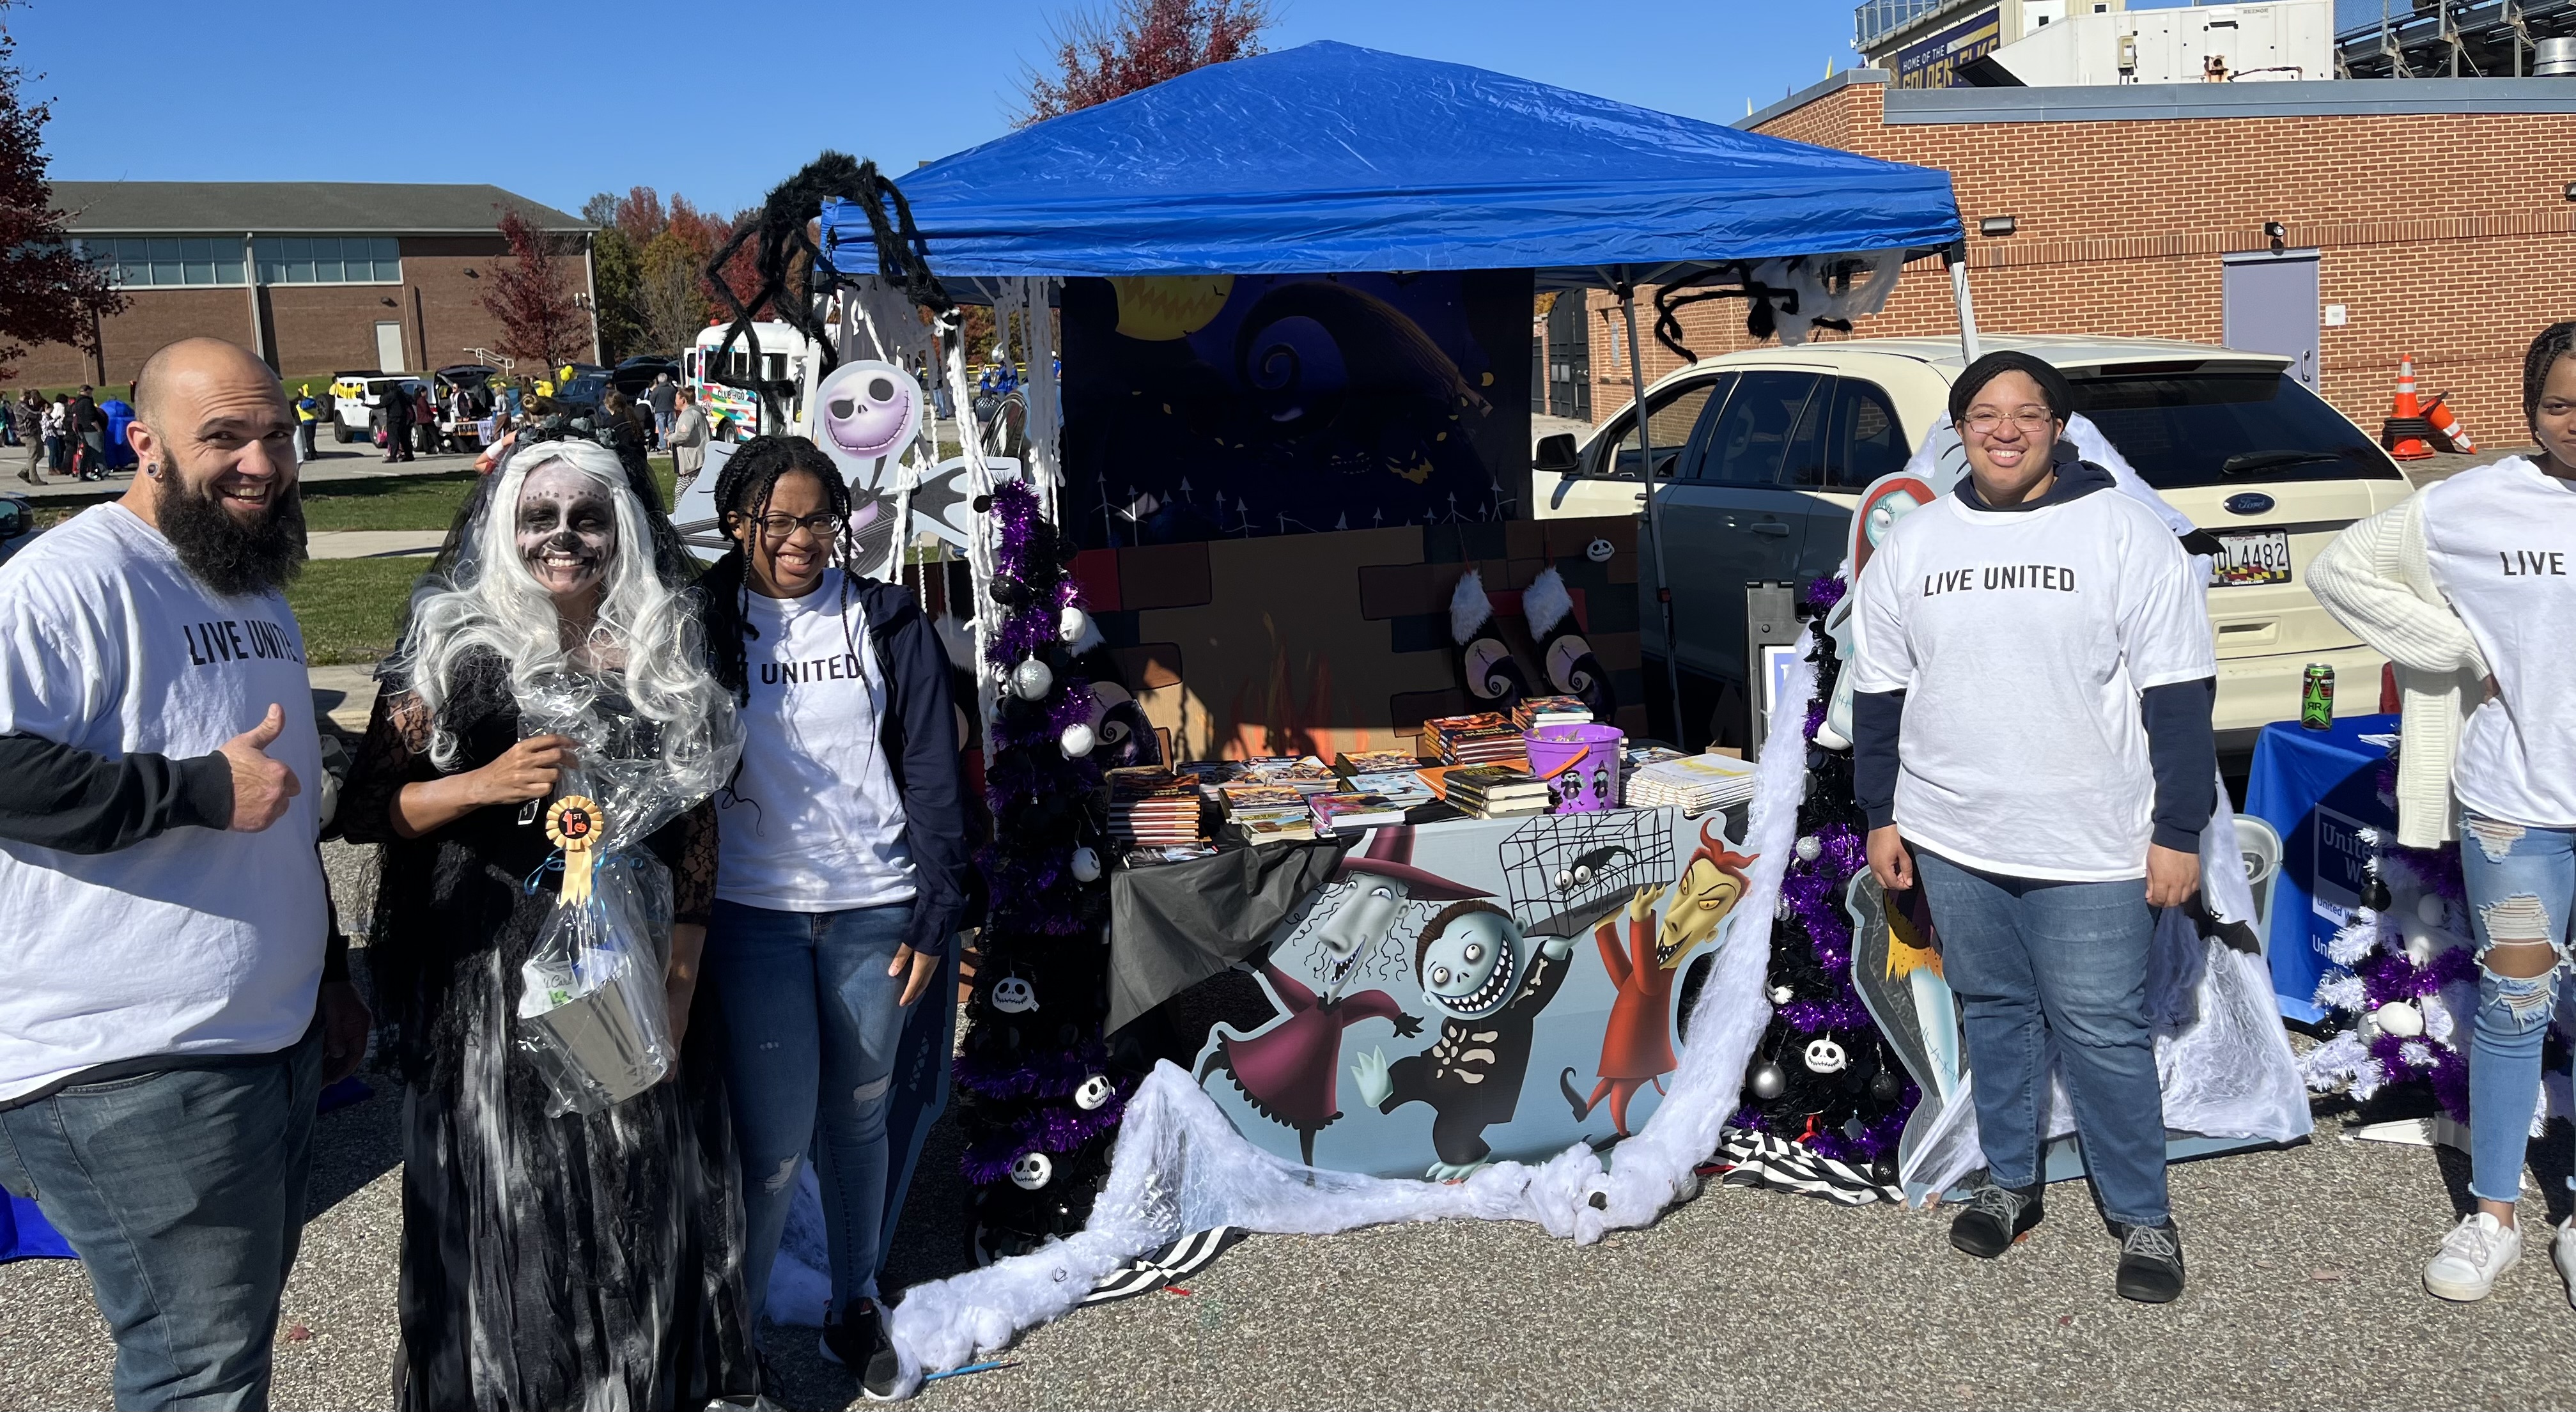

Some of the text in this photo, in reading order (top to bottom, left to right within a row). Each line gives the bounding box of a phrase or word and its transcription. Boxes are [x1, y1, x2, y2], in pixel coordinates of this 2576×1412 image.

[1903, 55, 1920, 72] HOME
[1921, 50, 1930, 64] OF
[1932, 45, 1944, 59] THE
[717, 389, 732, 399] CLUB
[737, 391, 745, 400] GO
[2238, 497, 2265, 509] Ford
[2213, 543, 2286, 571] DL4482
[2499, 550, 2566, 576] LIVE
[1924, 565, 2074, 597] LIVE UNITED
[183, 620, 303, 665] LIVE UNITE
[761, 653, 862, 685] UNITED
[562, 811, 582, 835] 1ST
[2317, 896, 2342, 917] United
